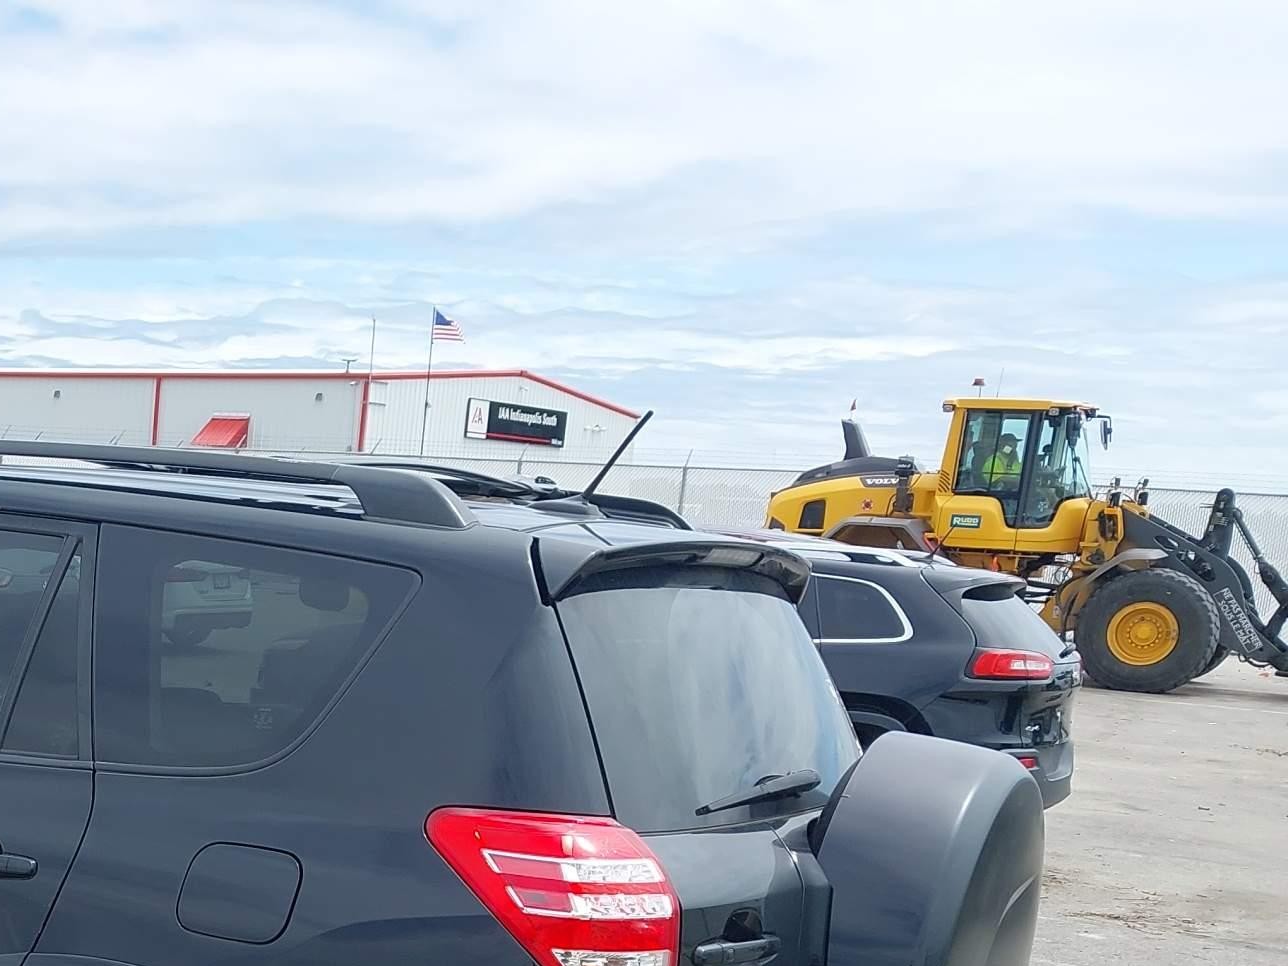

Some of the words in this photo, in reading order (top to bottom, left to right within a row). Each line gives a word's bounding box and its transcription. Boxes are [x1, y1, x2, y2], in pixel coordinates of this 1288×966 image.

[498, 406, 509, 420] IAA
[510, 407, 541, 426] Indianapolis
[542, 412, 557, 426] South
